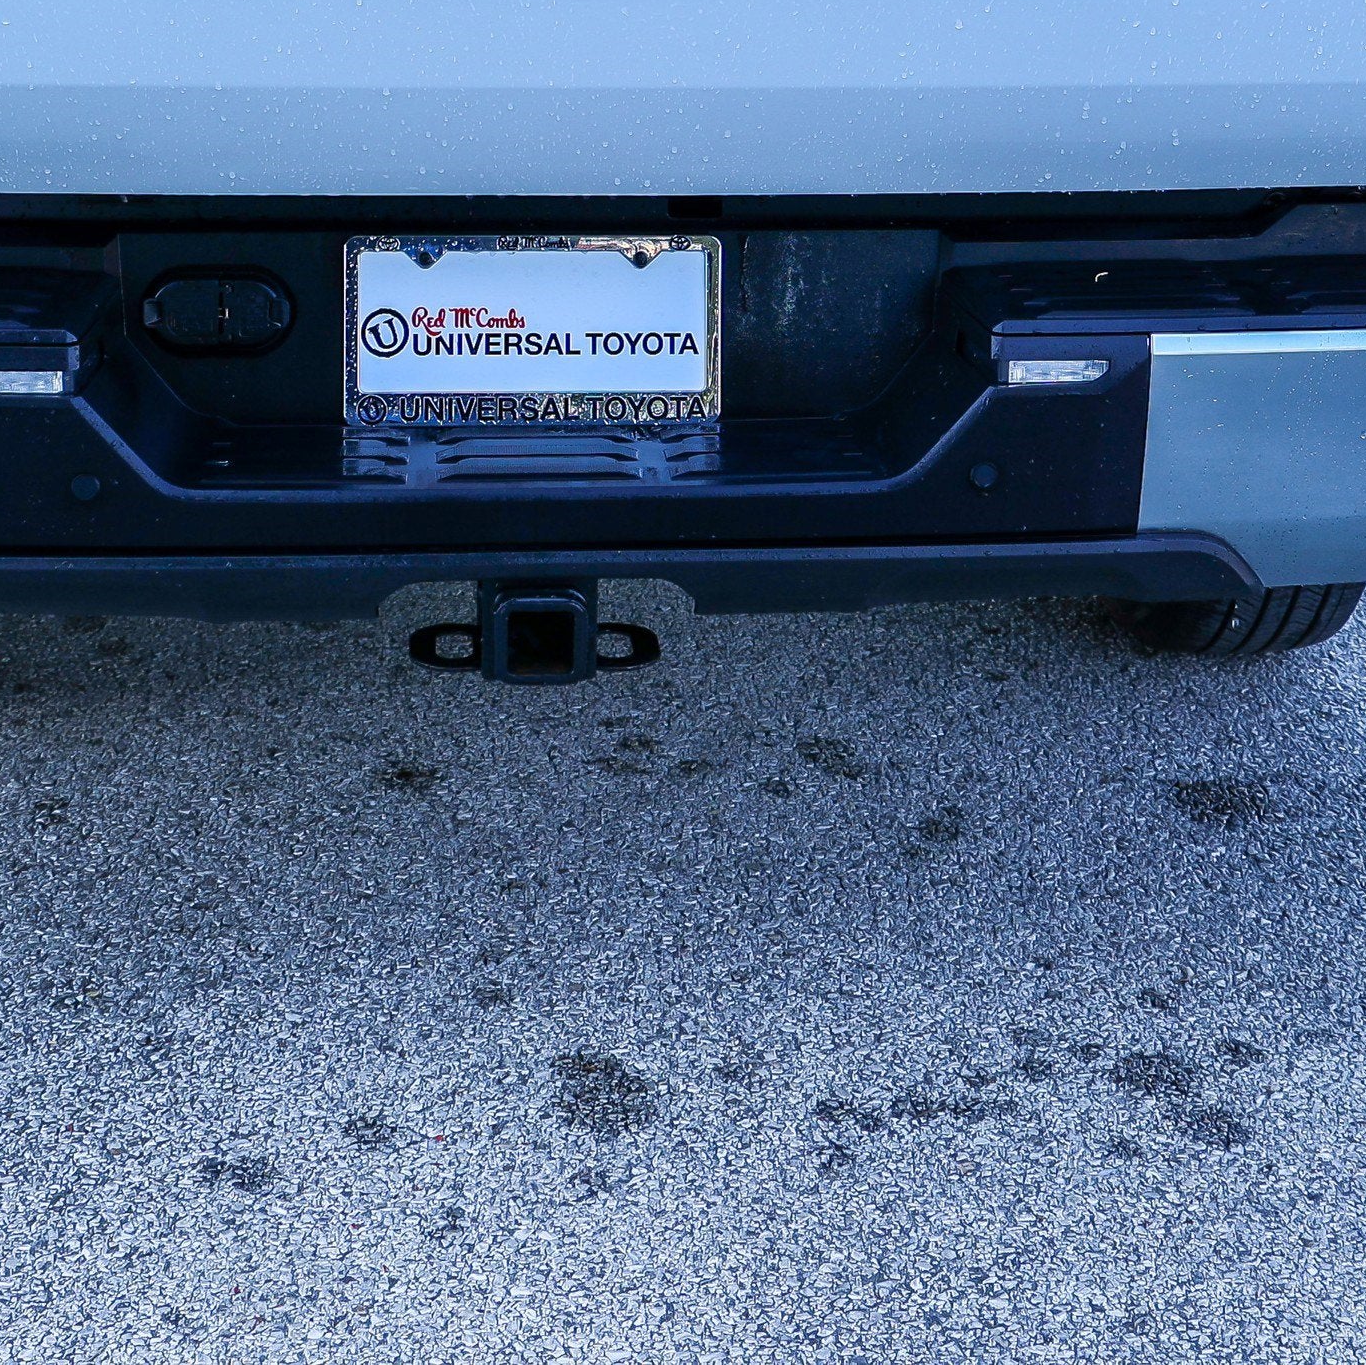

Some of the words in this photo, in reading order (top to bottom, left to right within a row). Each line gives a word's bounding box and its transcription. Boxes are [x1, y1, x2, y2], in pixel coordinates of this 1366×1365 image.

[412, 306, 446, 337] Red
[412, 333, 581, 356] UNIVERSAL
[586, 333, 699, 356] TOYOTA
[400, 396, 582, 422] UNIVERSAL
[587, 396, 707, 421] TOYOTA
